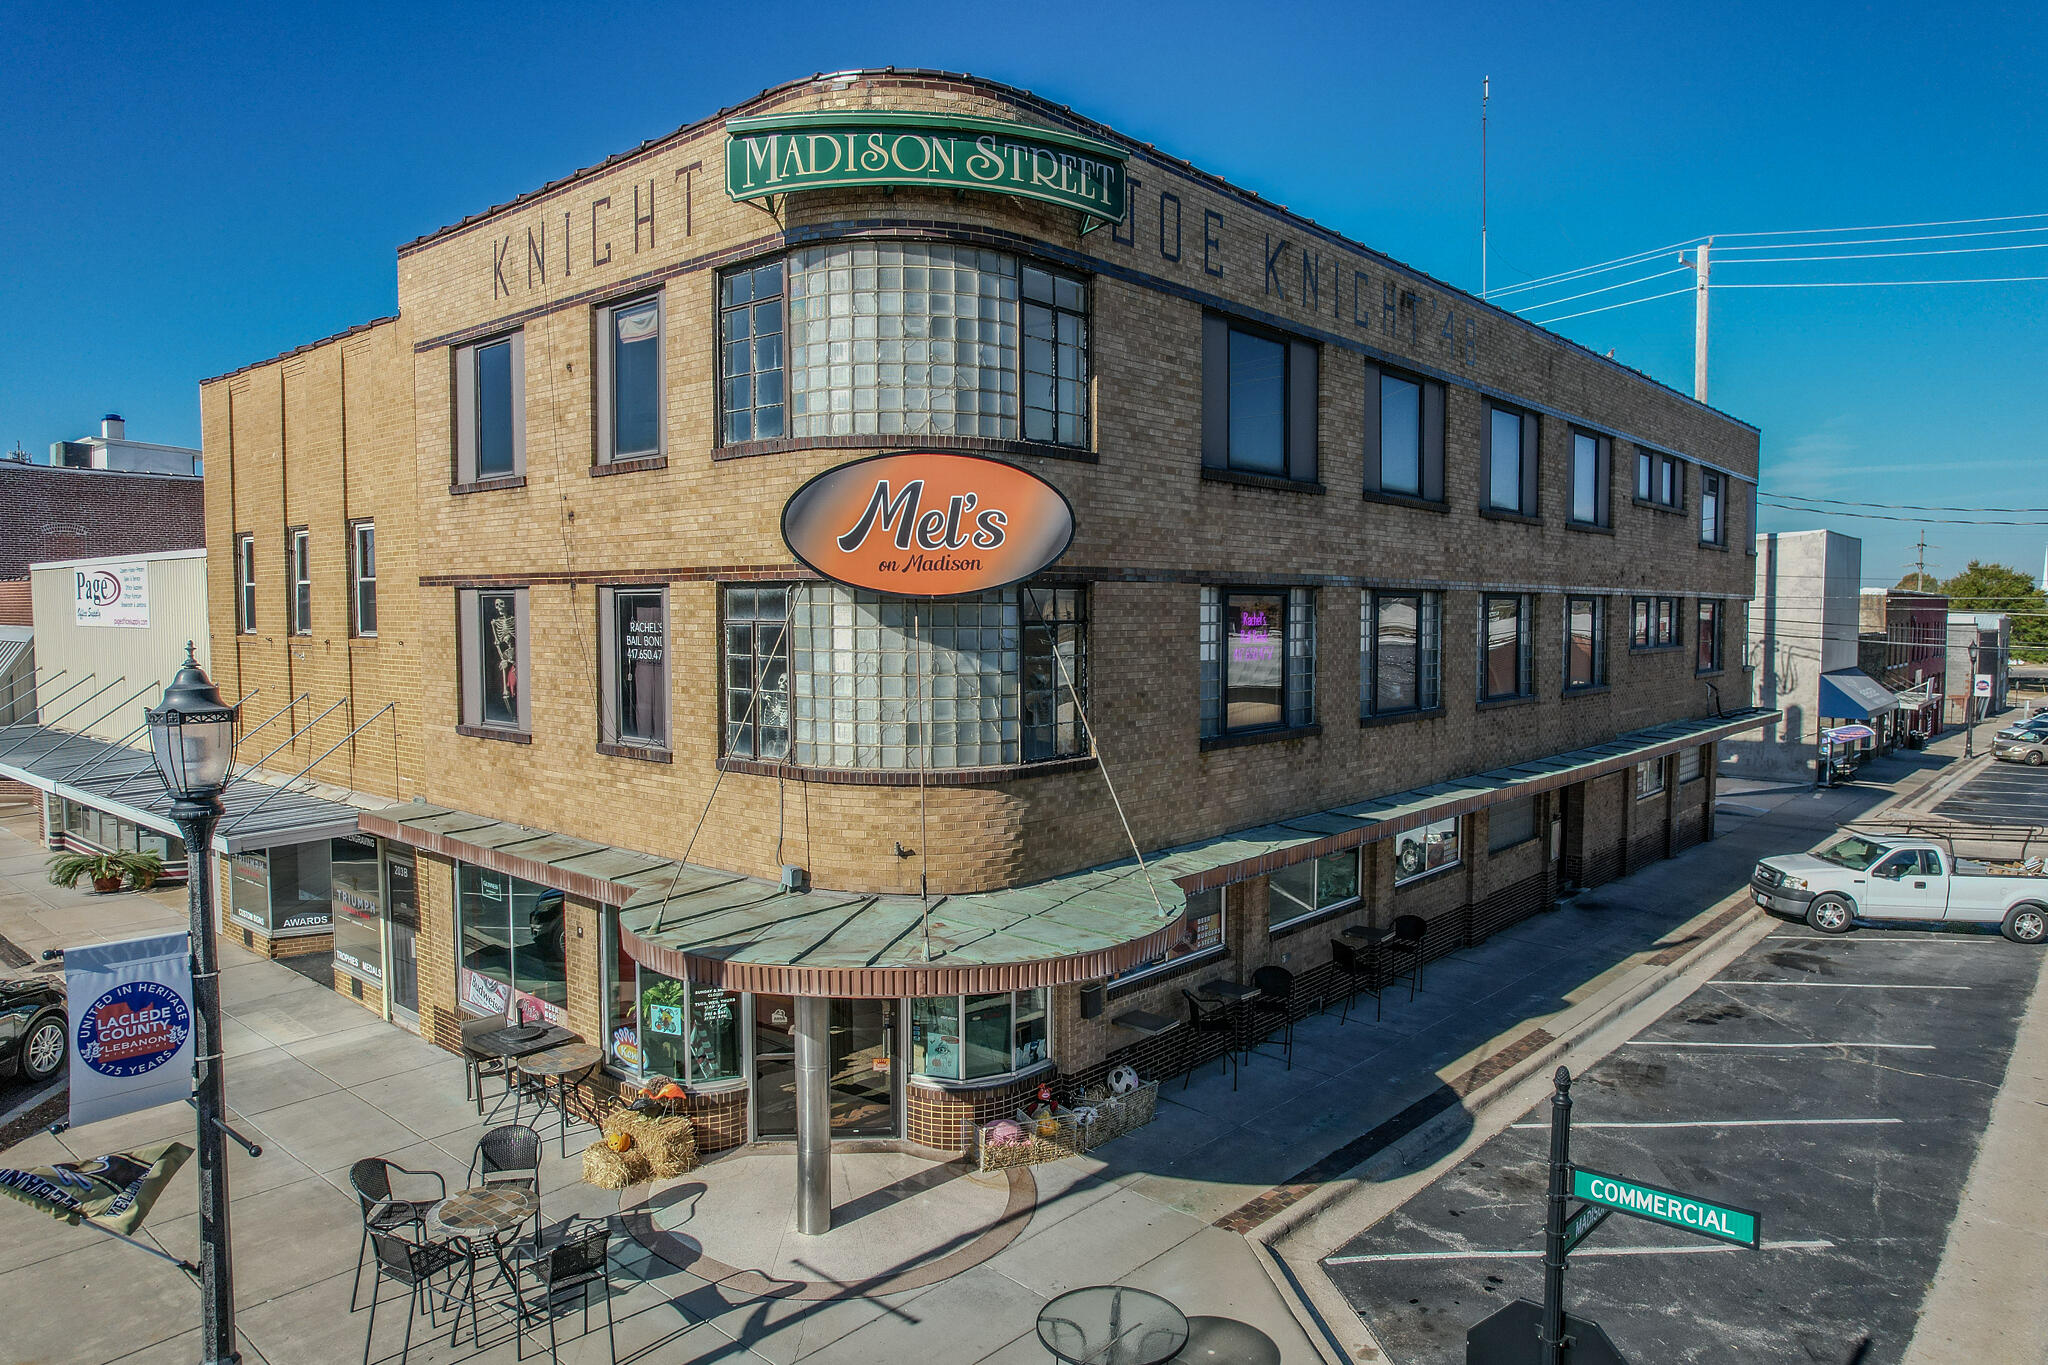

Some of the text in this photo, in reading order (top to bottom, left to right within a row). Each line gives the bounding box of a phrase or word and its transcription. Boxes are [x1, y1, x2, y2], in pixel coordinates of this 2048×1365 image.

[742, 132, 1115, 206] MADISON STREET
[493, 159, 702, 301] KNIGHT
[1111, 176, 1224, 280] JOE
[1264, 232, 1423, 347] KNIGHT
[836, 479, 1009, 553] Mel's
[878, 553, 985, 574] on Madison
[76, 571, 108, 606] Page
[626, 635, 642, 646] BAIL
[394, 865, 409, 878] 203B
[336, 889, 376, 914] TRIUMPH
[283, 915, 328, 928] AWARDS
[336, 949, 382, 978] TROPHIES MEDALS
[80, 983, 188, 1038] UNITED IN HERITAGE
[97, 1006, 171, 1031] LACLEDE
[99, 1018, 171, 1042] COUNTY
[104, 1034, 168, 1053] LEBANON
[98, 1049, 172, 1076] 175 YEARS
[1590, 1179, 1735, 1235] COMMERCIAL
